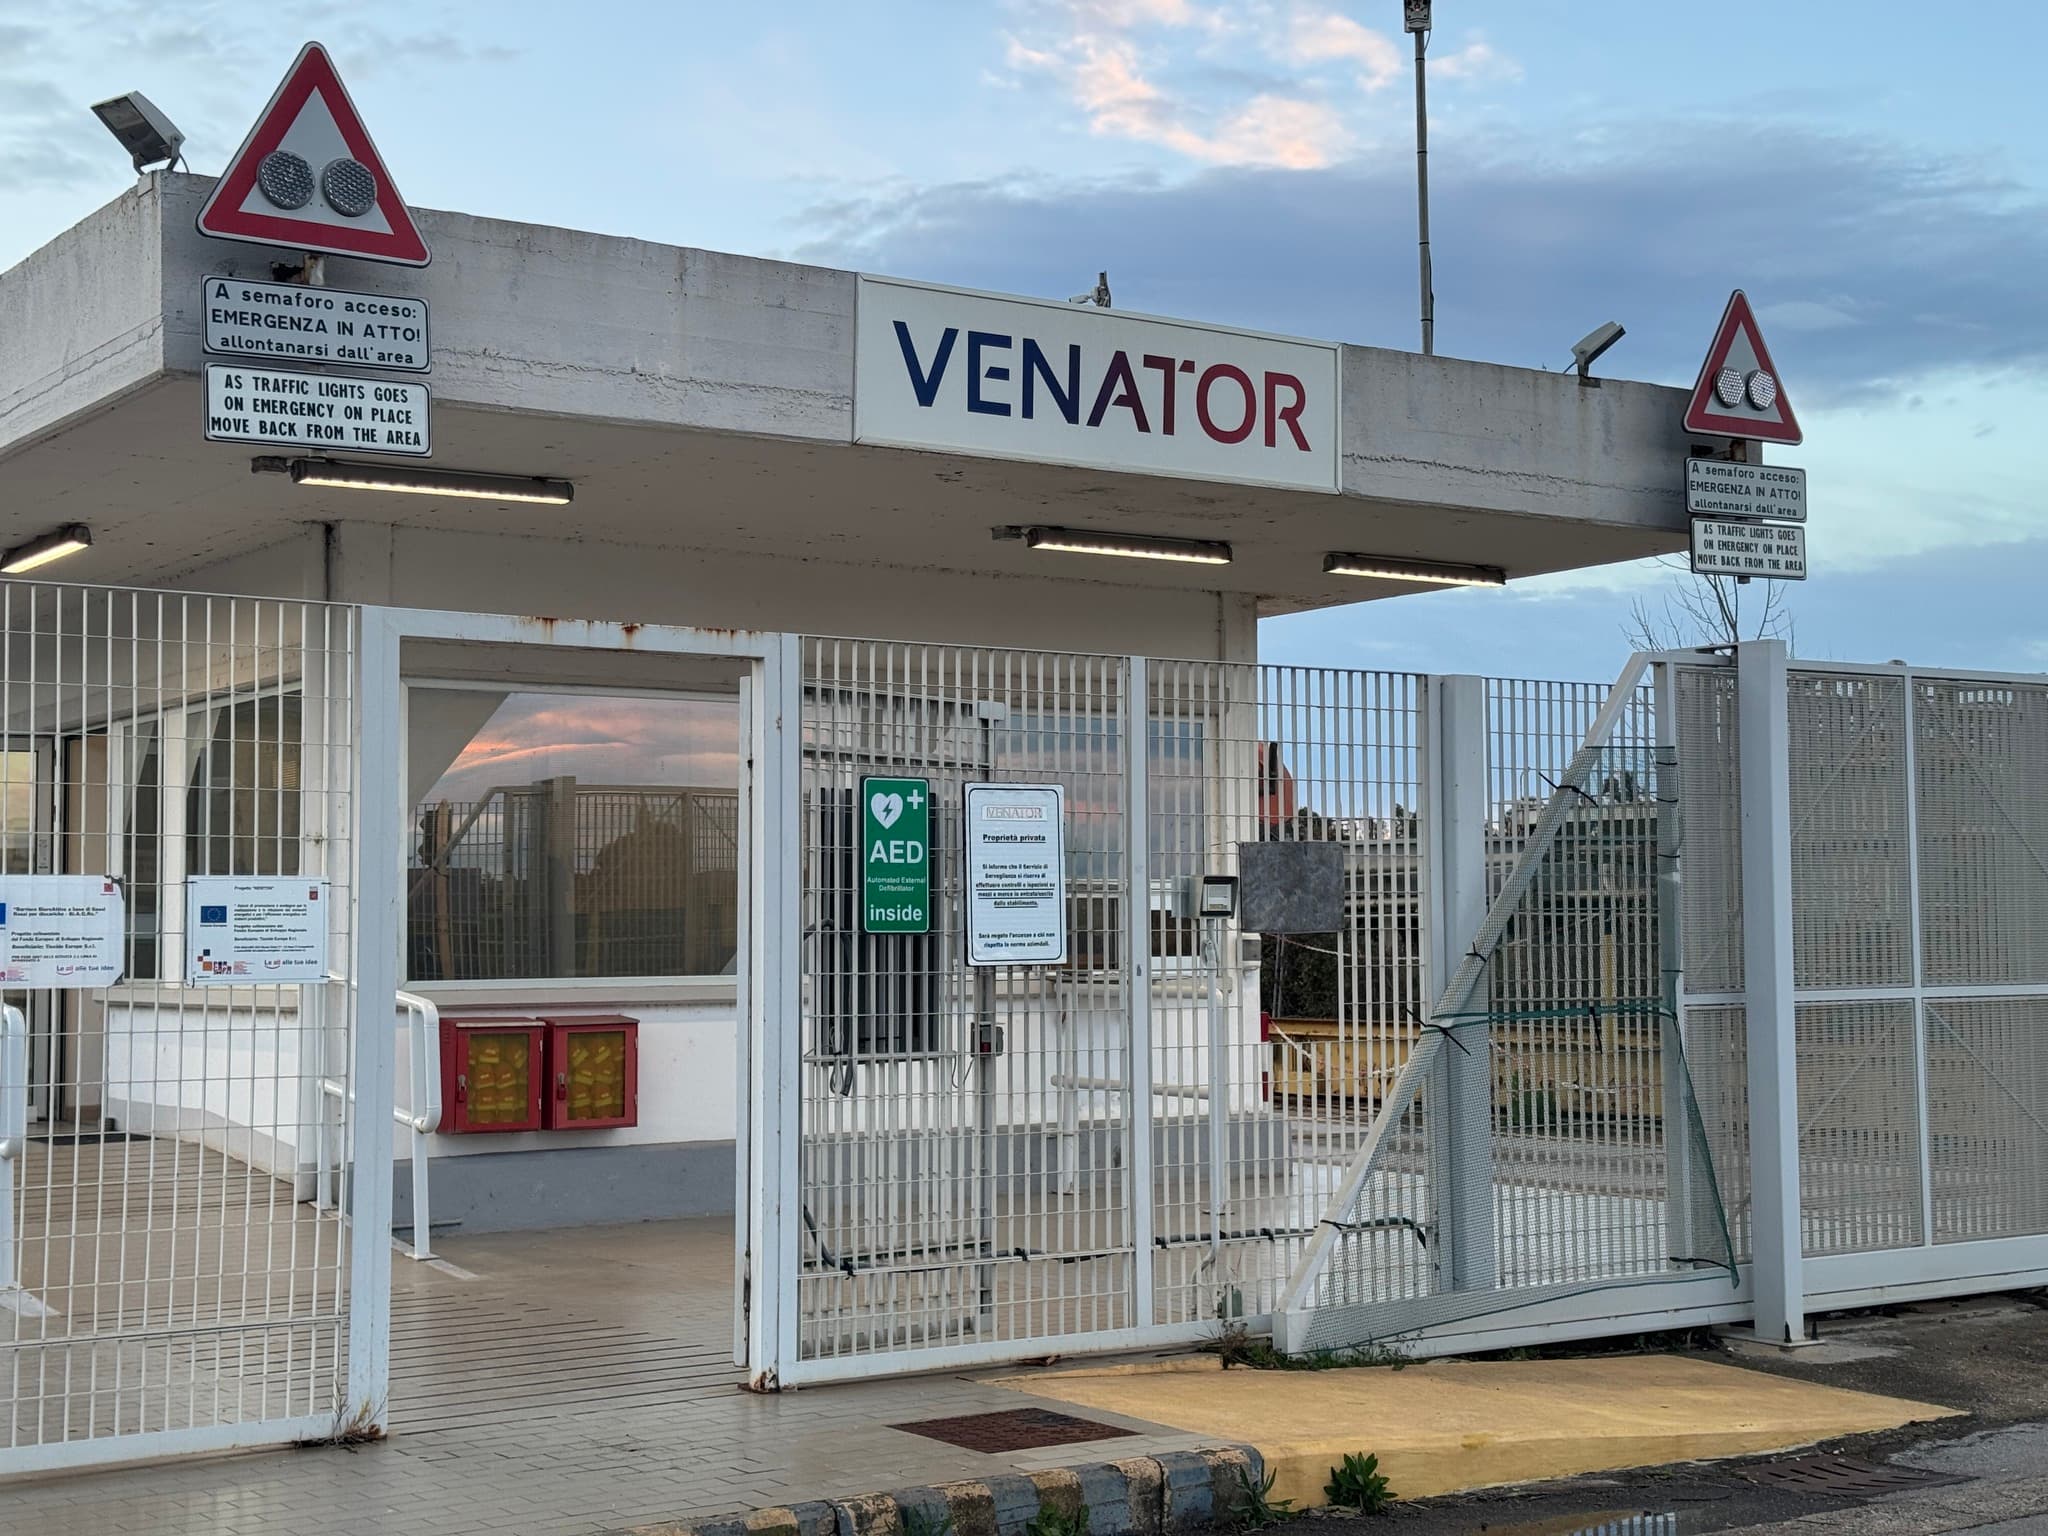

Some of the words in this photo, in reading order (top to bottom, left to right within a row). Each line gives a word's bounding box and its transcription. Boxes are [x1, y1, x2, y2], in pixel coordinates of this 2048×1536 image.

[216, 283, 229, 299] A
[242, 289, 334, 309] semaforo
[345, 300, 416, 318] acceso:
[212, 309, 328, 333] EMERGENZA
[338, 322, 353, 336] IN
[363, 324, 420, 342] ATTO!
[220, 335, 329, 356] allontanarsi
[225, 375, 242, 389] AS
[253, 377, 308, 395] TRAFFIC
[319, 383, 365, 399] LIGHTS
[374, 387, 407, 403] GOES
[893, 320, 1312, 451] VENATOR
[225, 397, 243, 411] ON
[253, 399, 334, 418] EMERGENCY
[344, 405, 362, 420] ON
[372, 408, 412, 424] PLACE
[211, 417, 250, 433] MOVE
[259, 421, 297, 437] BACK
[307, 424, 344, 440] FROM
[353, 428, 377, 443] THE
[387, 430, 421, 446] AREA
[1692, 462, 1700, 473] A
[1706, 466, 1755, 478] semaforo
[1760, 472, 1799, 484] acceso:
[1690, 481, 1751, 496] EMERGENZA
[1756, 487, 1765, 496] IN
[1695, 499, 1752, 512] allontanarsi
[1704, 524, 1712, 534] AS
[1718, 525, 1746, 537] TRAFFIC
[1750, 528, 1773, 539] LIGHTS
[1778, 530, 1795, 540] GOES
[1704, 539, 1713, 549] ON
[1718, 540, 1758, 553] EMERGENCY
[1763, 544, 1772, 554] ON
[1777, 545, 1798, 556] PLACE
[1697, 554, 1717, 565] MOVE
[1721, 556, 1740, 567] BACK
[1745, 557, 1764, 568] FROM
[1768, 559, 1781, 569] THE
[1785, 561, 1803, 571] AREA
[987, 807, 1042, 818] VENATOR
[983, 834, 1017, 842] Proprietà
[1020, 834, 1046, 842] privata
[870, 840, 923, 863] AED
[870, 904, 922, 921] inside
